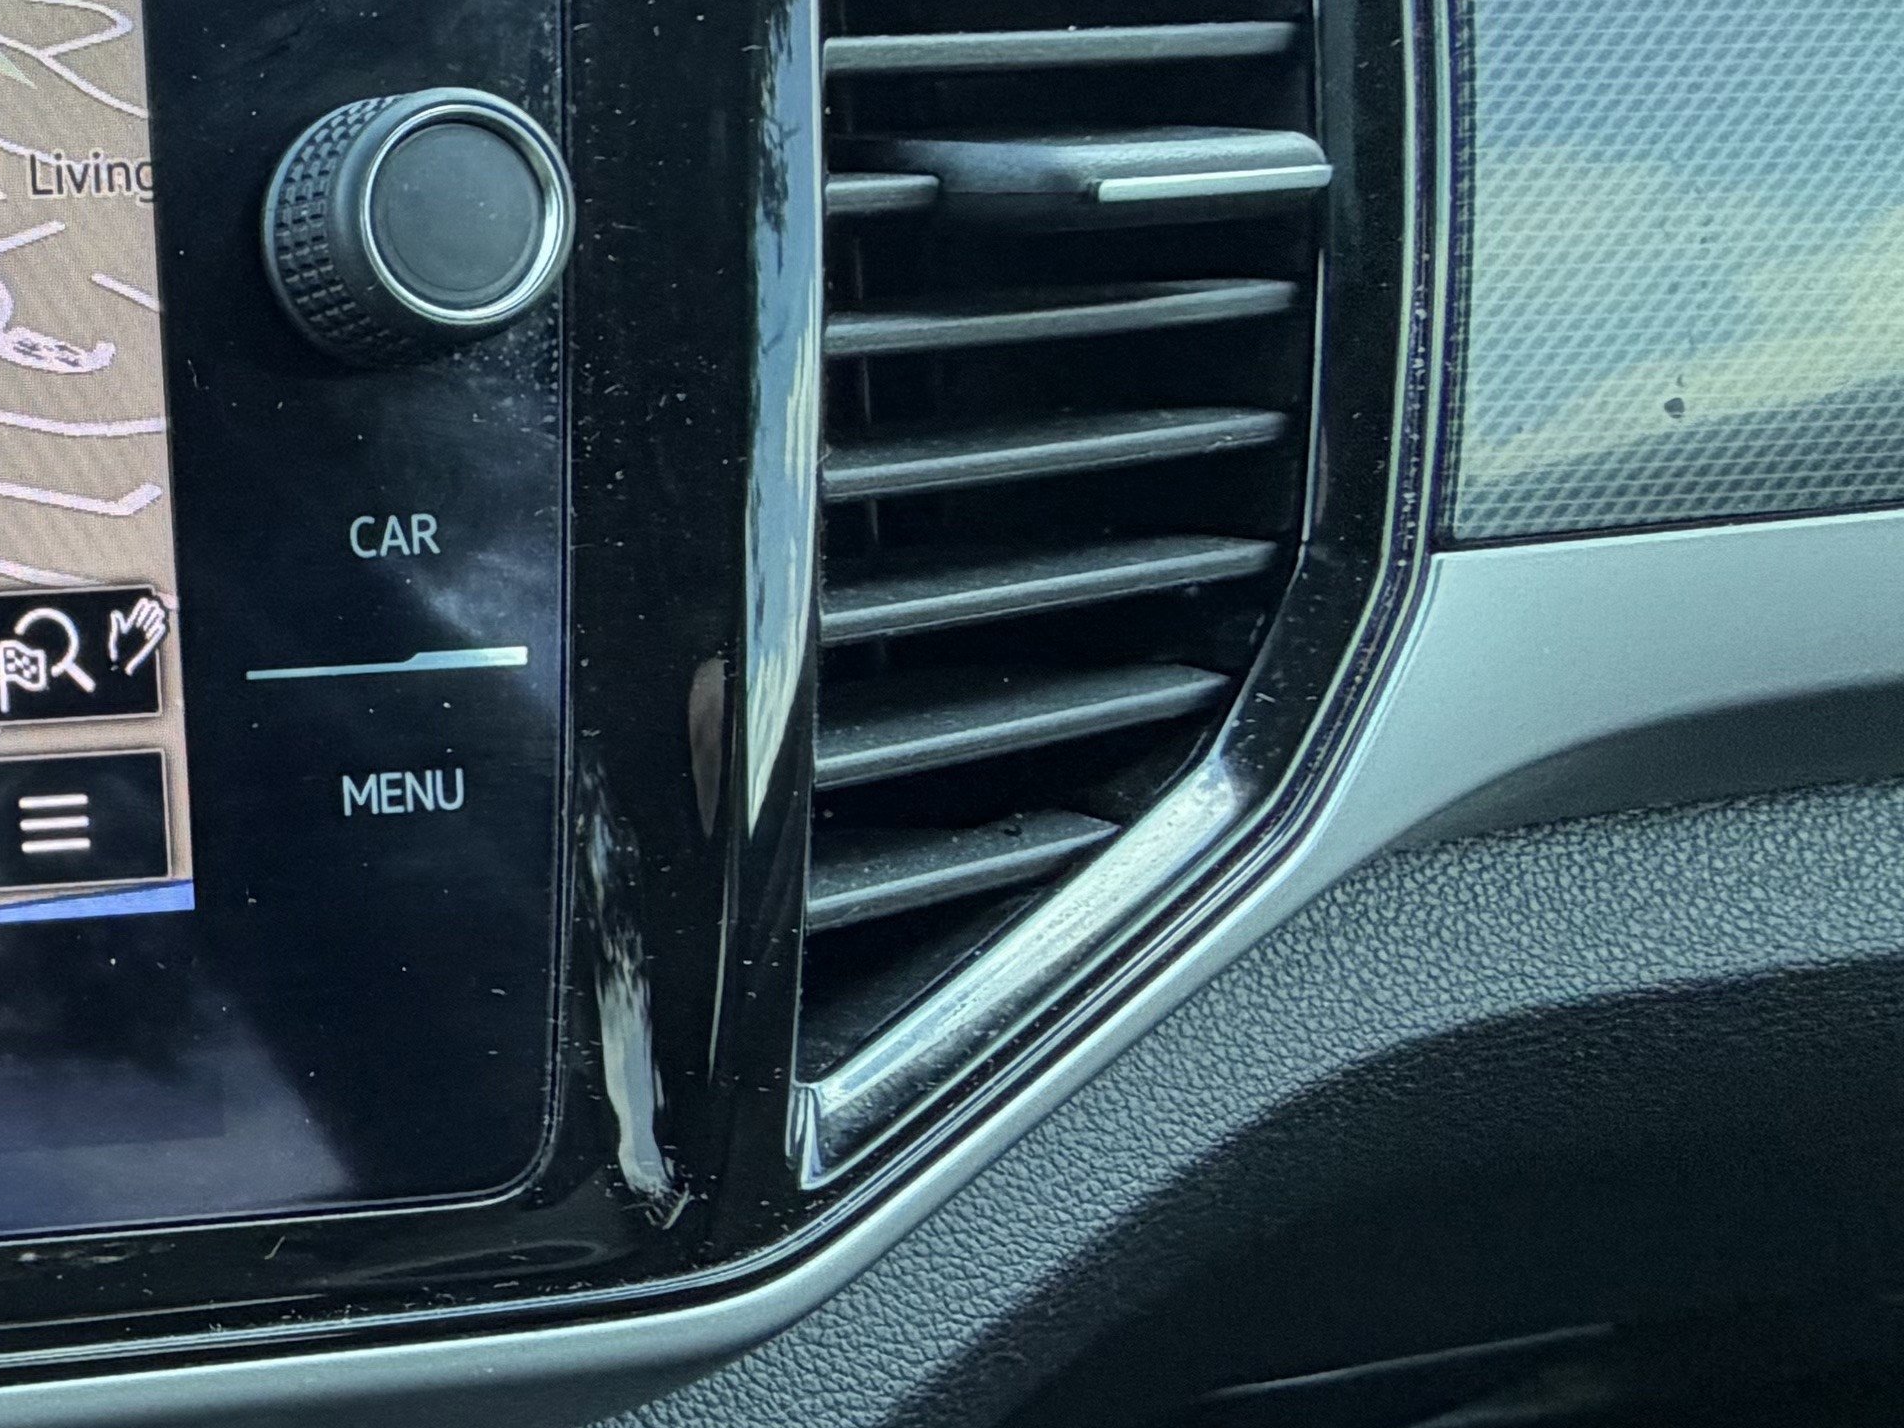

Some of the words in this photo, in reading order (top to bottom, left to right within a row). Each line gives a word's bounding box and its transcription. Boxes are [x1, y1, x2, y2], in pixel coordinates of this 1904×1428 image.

[30, 151, 154, 203] Living
[348, 512, 441, 559] CAR
[341, 767, 466, 817] MENU
